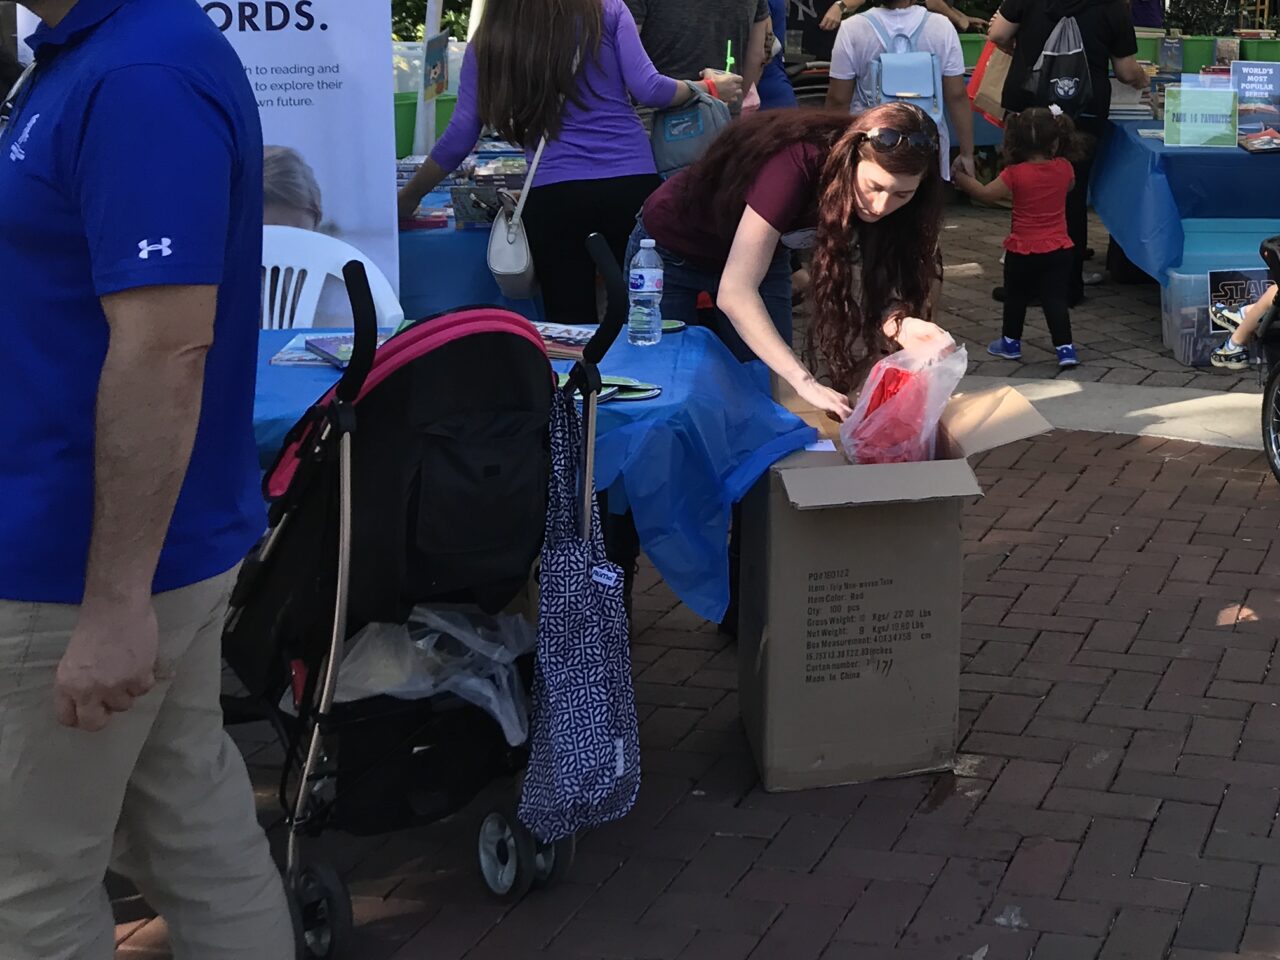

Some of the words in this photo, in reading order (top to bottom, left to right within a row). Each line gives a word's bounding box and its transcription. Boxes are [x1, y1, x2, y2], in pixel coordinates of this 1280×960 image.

[202, 0, 329, 32] ORDS.
[255, 65, 268, 76] to
[270, 64, 315, 77] reading
[317, 63, 340, 75] and
[1241, 66, 1274, 74] WORLD'S
[255, 81, 268, 92] to
[270, 80, 315, 93] explore
[317, 79, 344, 90] their
[259, 98, 274, 107] wn
[276, 96, 315, 107] future.
